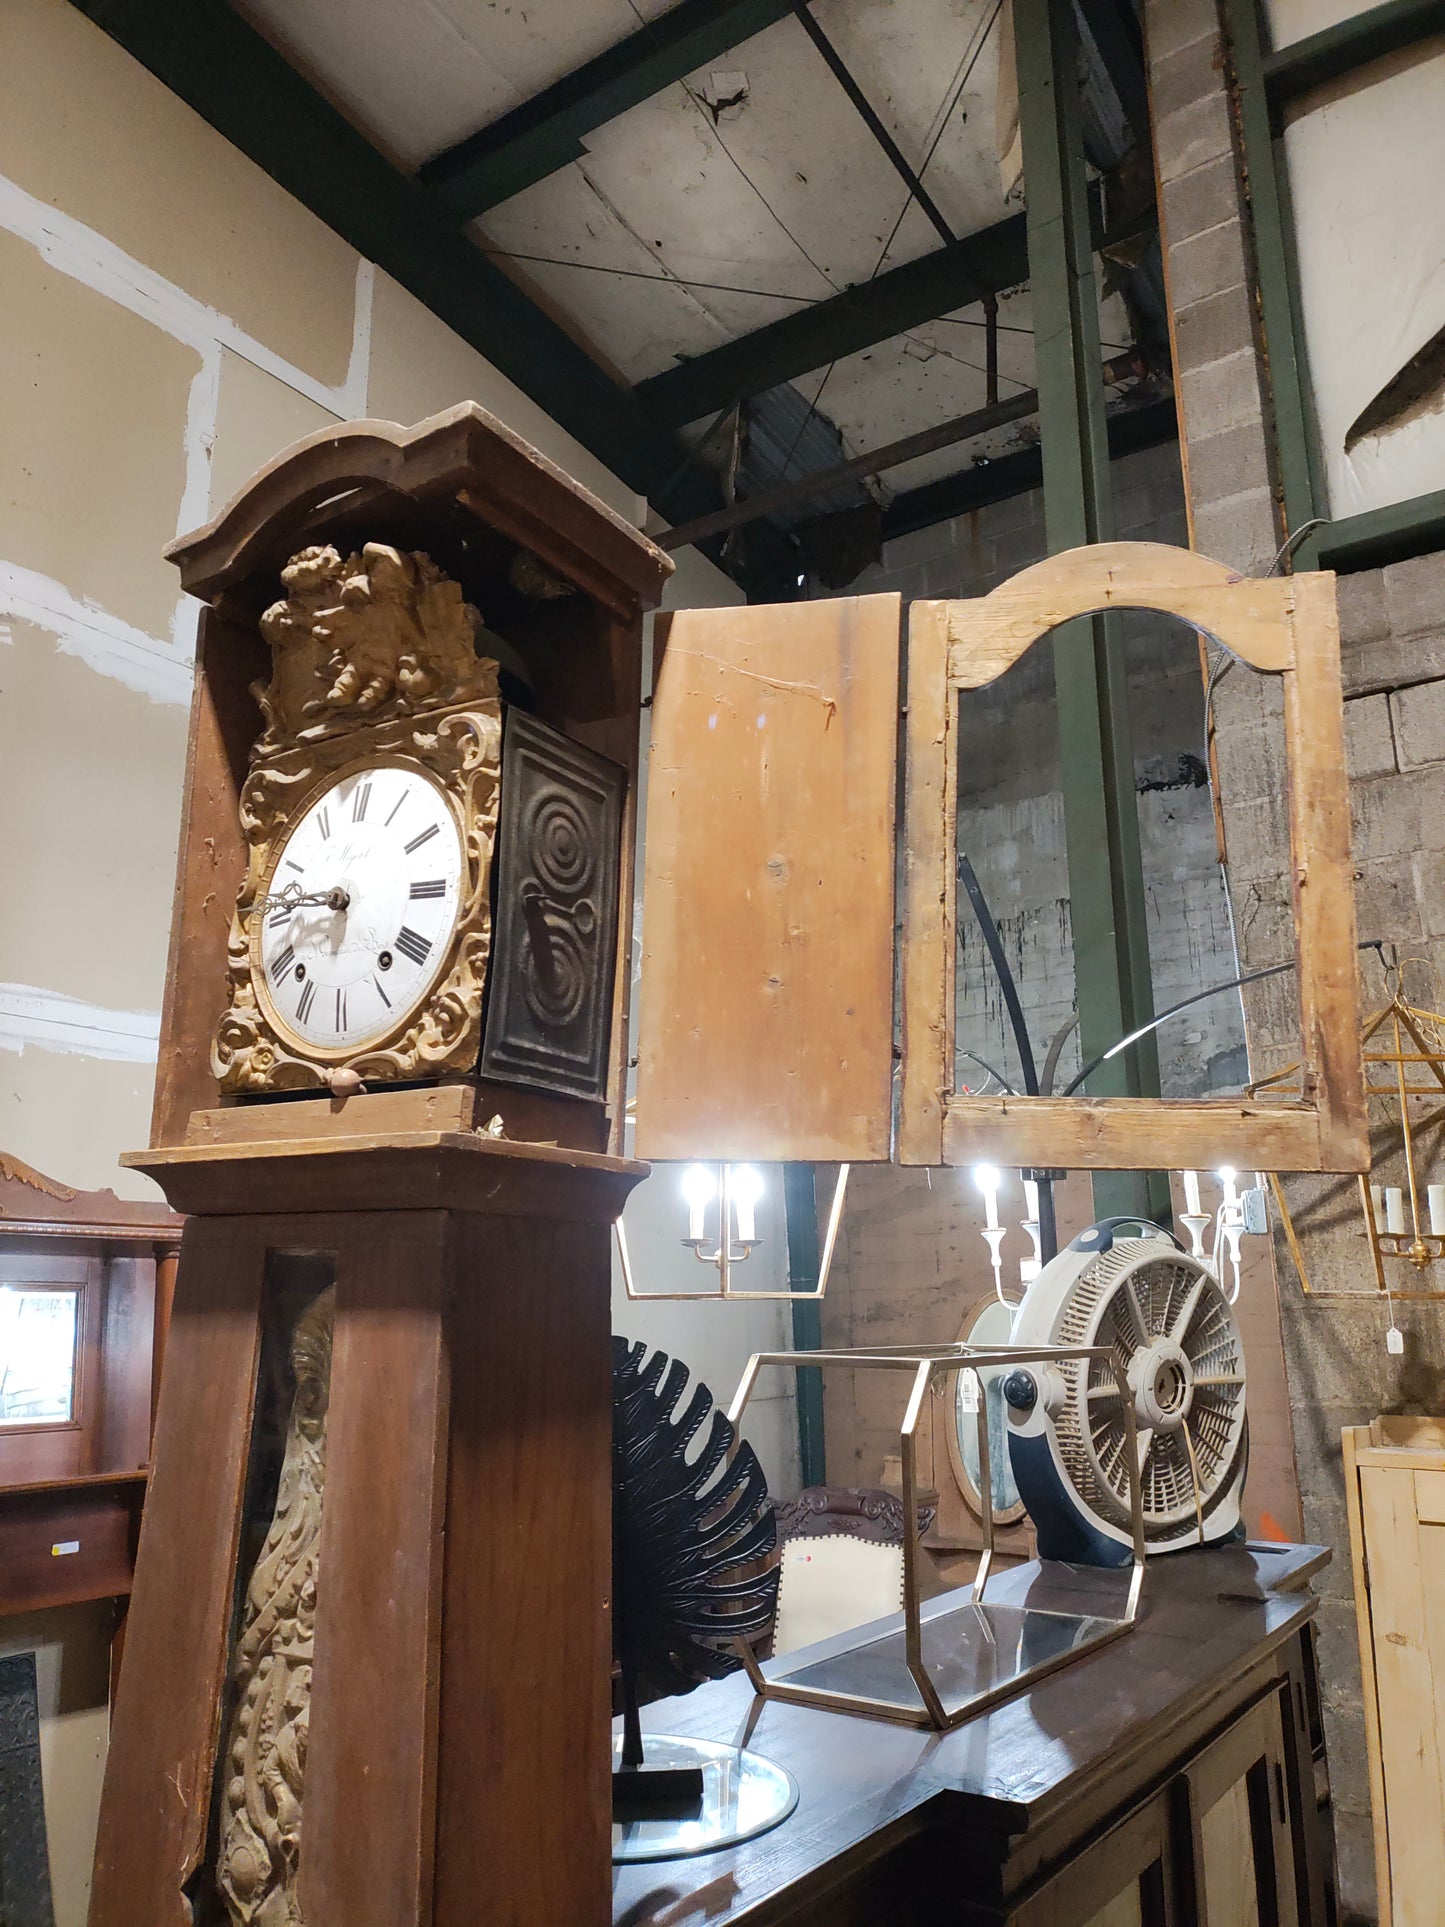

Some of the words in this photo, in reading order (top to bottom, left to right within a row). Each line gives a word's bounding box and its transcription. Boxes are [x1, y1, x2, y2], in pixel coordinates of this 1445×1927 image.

[384, 789, 409, 827] I
[404, 823, 440, 855] II
[409, 879, 447, 900] III
[393, 925, 433, 967] IIII
